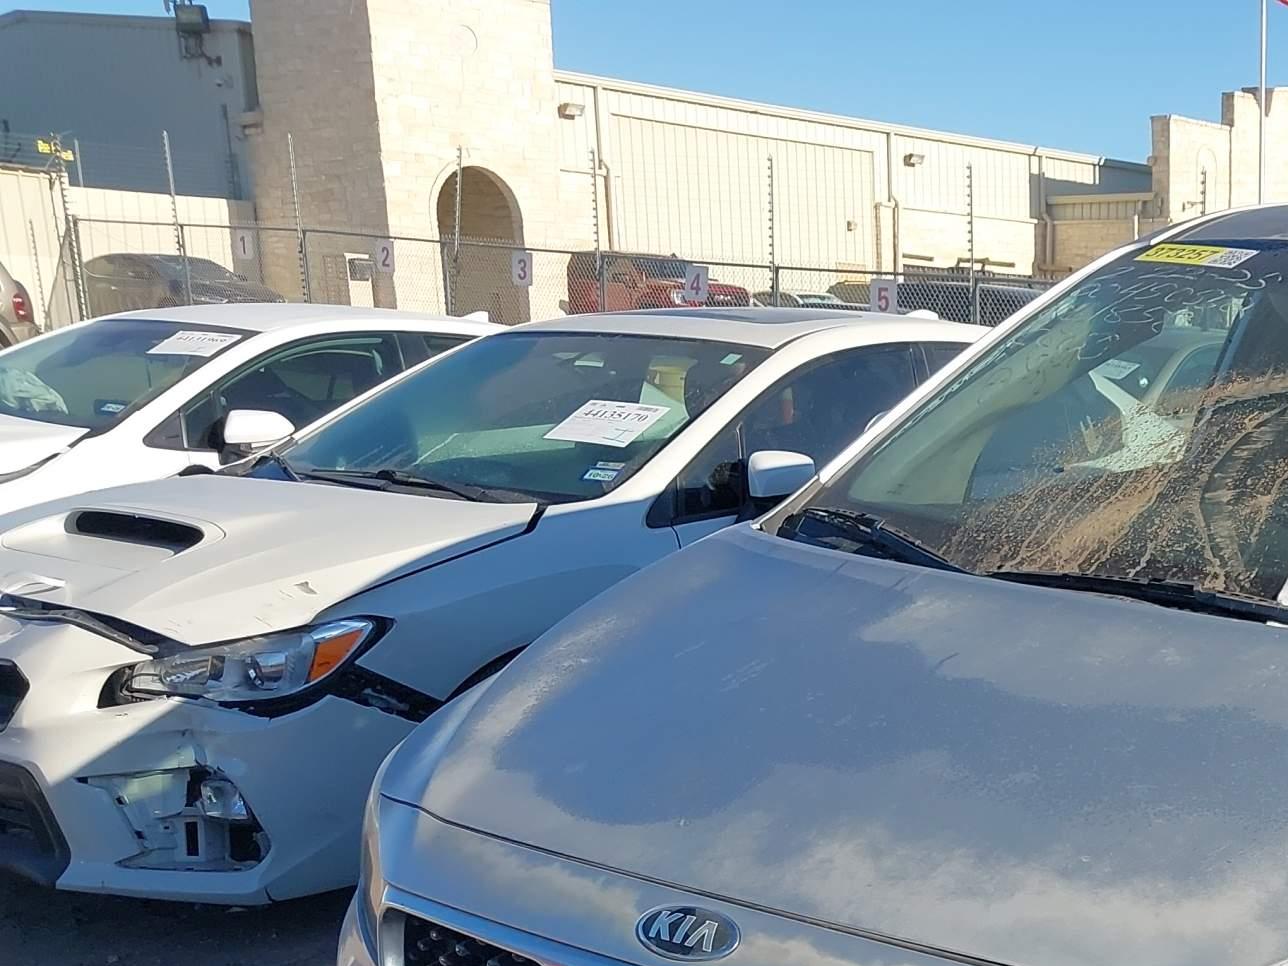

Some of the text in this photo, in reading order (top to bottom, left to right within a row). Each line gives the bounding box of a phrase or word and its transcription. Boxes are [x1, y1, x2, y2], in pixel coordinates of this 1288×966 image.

[240, 236, 246, 255] 1
[1146, 247, 1220, 261] 373257
[381, 246, 390, 267] 2
[517, 259, 528, 281] 3
[690, 273, 702, 296] 4
[877, 287, 889, 312] 5
[583, 408, 649, 423] 44135170
[648, 910, 719, 953] KIA
